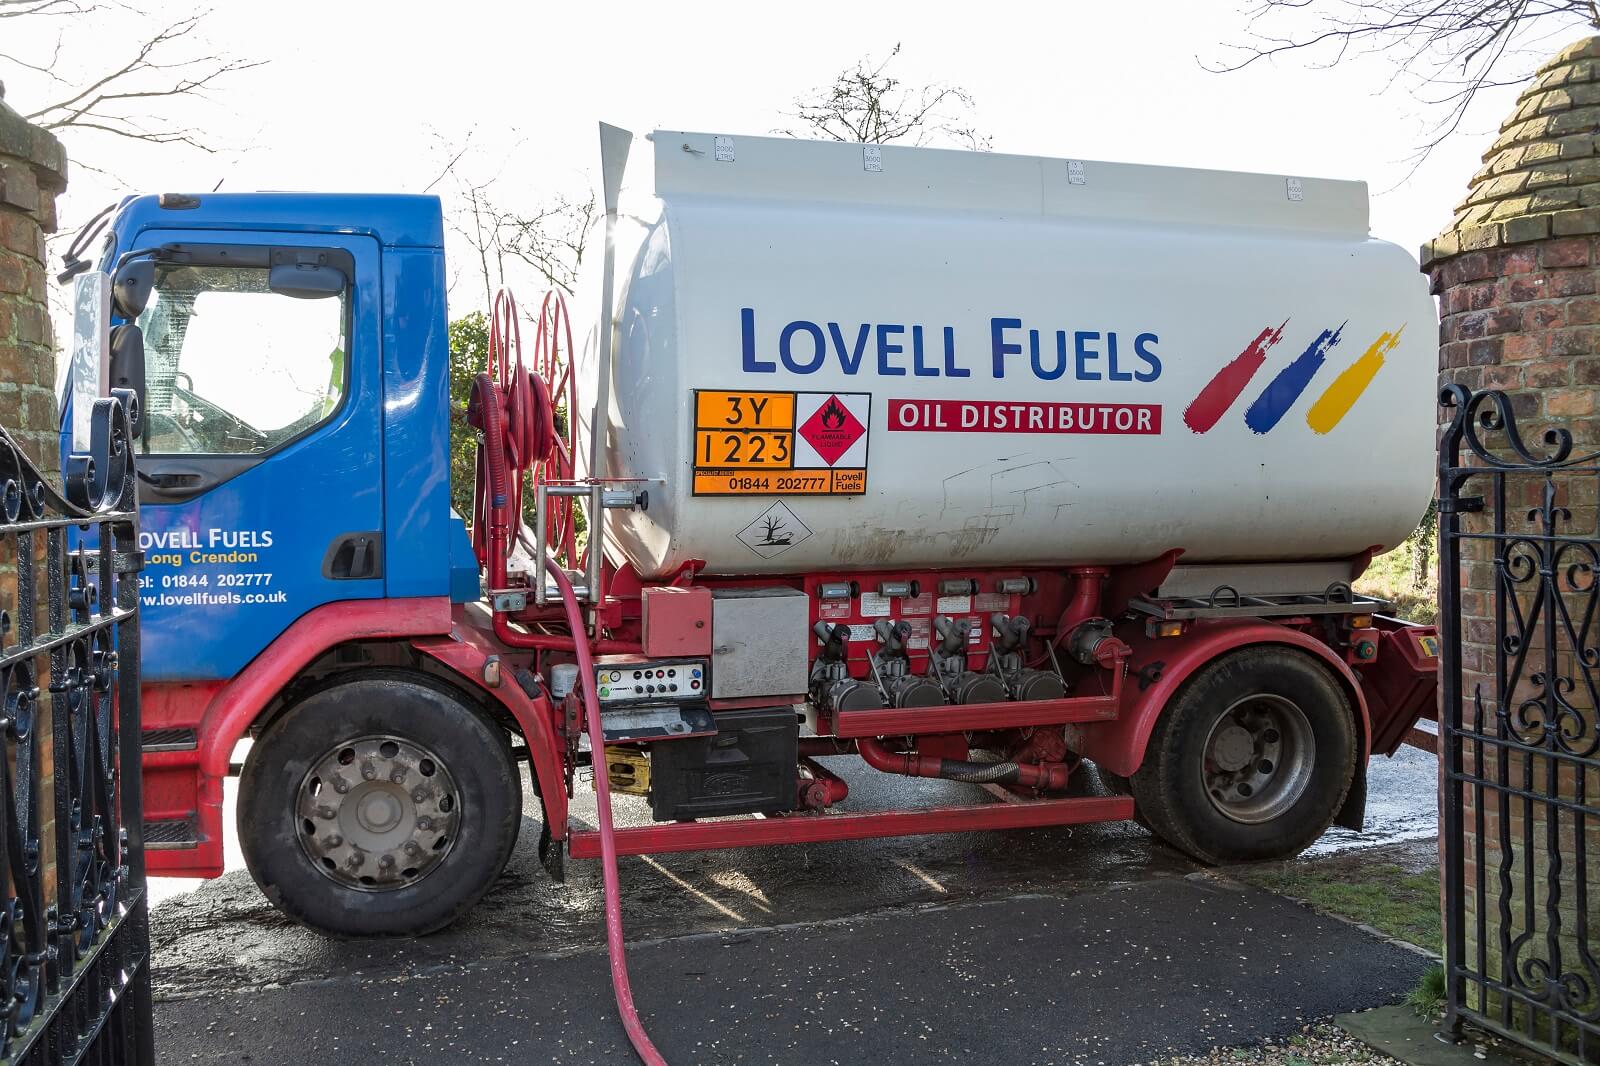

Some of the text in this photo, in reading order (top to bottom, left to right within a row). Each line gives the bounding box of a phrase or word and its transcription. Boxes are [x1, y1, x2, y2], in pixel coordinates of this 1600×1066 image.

[741, 307, 1163, 383] LOVELL FUELS
[725, 397, 769, 425] 3Y
[898, 403, 1152, 431] OIL DISTRIBUTOR
[705, 434, 789, 463] 1223
[820, 440, 844, 448] LIQUID
[729, 477, 826, 490] 01844 202777
[835, 472, 863, 482] Lovell
[835, 482, 862, 491] Fuels
[138, 528, 273, 549] OVELL FUELS
[189, 551, 258, 564] Crendon
[138, 573, 273, 589] el: 01844 202777
[138, 590, 288, 606] w.lovellfuels.co.uk
